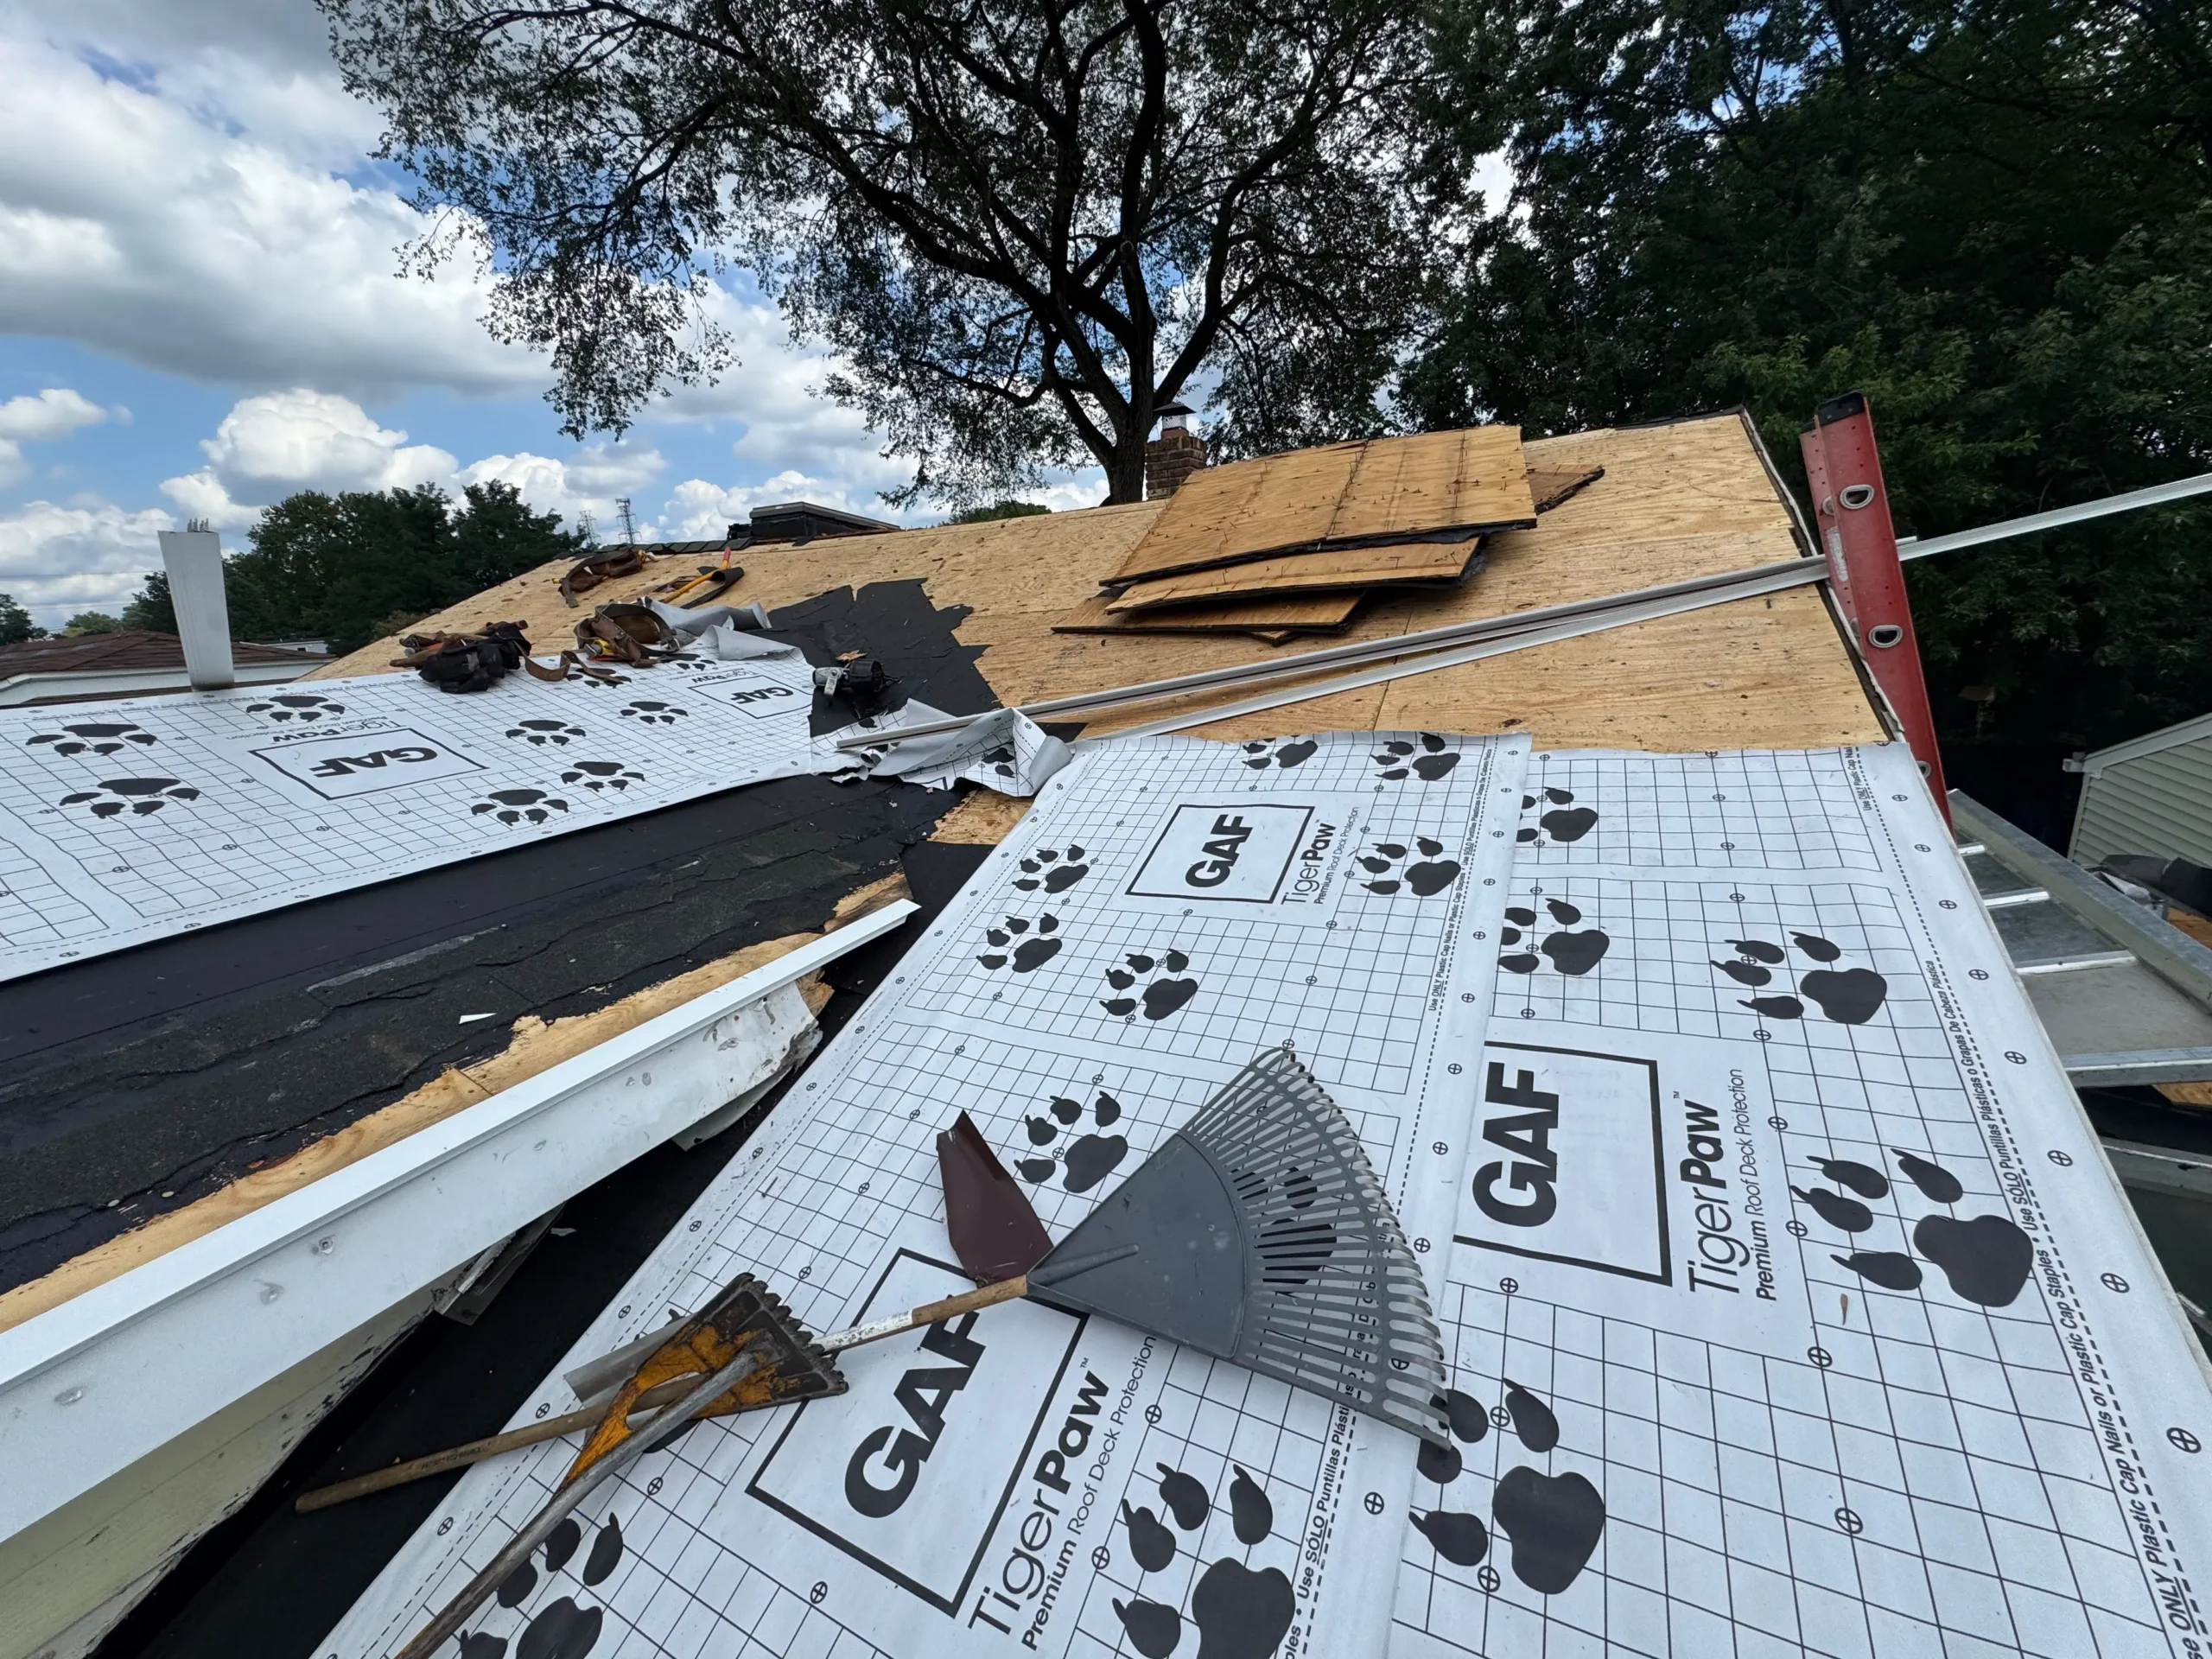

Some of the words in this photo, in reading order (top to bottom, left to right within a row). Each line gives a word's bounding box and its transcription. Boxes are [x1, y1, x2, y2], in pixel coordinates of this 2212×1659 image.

[730, 686, 794, 704] GAF
[273, 718, 407, 743] TigerPaw
[308, 747, 437, 778] GAF
[1185, 814, 1254, 887] GAF
[1281, 823, 1337, 905] TigerPaw
[1313, 872, 1334, 905] Premium
[1340, 806, 1360, 837] Protection
[1449, 904, 1459, 922] Plastic
[1453, 893, 1462, 903] Cap
[1440, 944, 1452, 957] Cap
[1443, 929, 1453, 944] Nails
[1436, 958, 1447, 978] Plastic
[1428, 995, 1439, 1012] Use
[1432, 980, 1444, 997] ONLY
[1938, 991, 1956, 1020] Cabeza
[1949, 1020, 1961, 1033] De
[1957, 1034, 1974, 1066] Grapas
[1728, 1069, 1751, 1135] Protection
[1971, 1077, 1994, 1122] Plásticas
[1472, 1062, 1559, 1228] GAF
[1736, 1138, 1758, 1177] Deck
[1988, 1124, 2010, 1169] Puntillas
[1680, 1100, 1751, 1294] TigerPaw
[1742, 1179, 1765, 1217] Roof
[2003, 1172, 2033, 1206] SÓLO
[2020, 1208, 2038, 1231] Use
[1754, 1220, 1777, 1300] Premium
[2037, 1249, 2065, 1298] Staples
[2057, 1301, 2076, 1330] Cap
[2069, 1332, 2100, 1385] Plastic
[844, 1294, 987, 1518] GAF
[2089, 1387, 2107, 1407] or
[2097, 1410, 2126, 1454] Nails
[1021, 1538, 1079, 1650] Premium
[1068, 1482, 1098, 1535] Roof
[1089, 1427, 1121, 1481] Deck
[1111, 1336, 1157, 1427] Protection
[2115, 1459, 2139, 1495] Cap
[968, 1370, 1109, 1635] TigerPaw
[1297, 1565, 1314, 1599] Use
[1306, 1515, 1328, 1565] SÓLO
[1317, 1448, 1340, 1513] Puntillas
[2129, 1499, 2168, 1567] Plastic
[2152, 1569, 2200, 1636] ONLY
[2182, 1637, 2204, 1659] se
